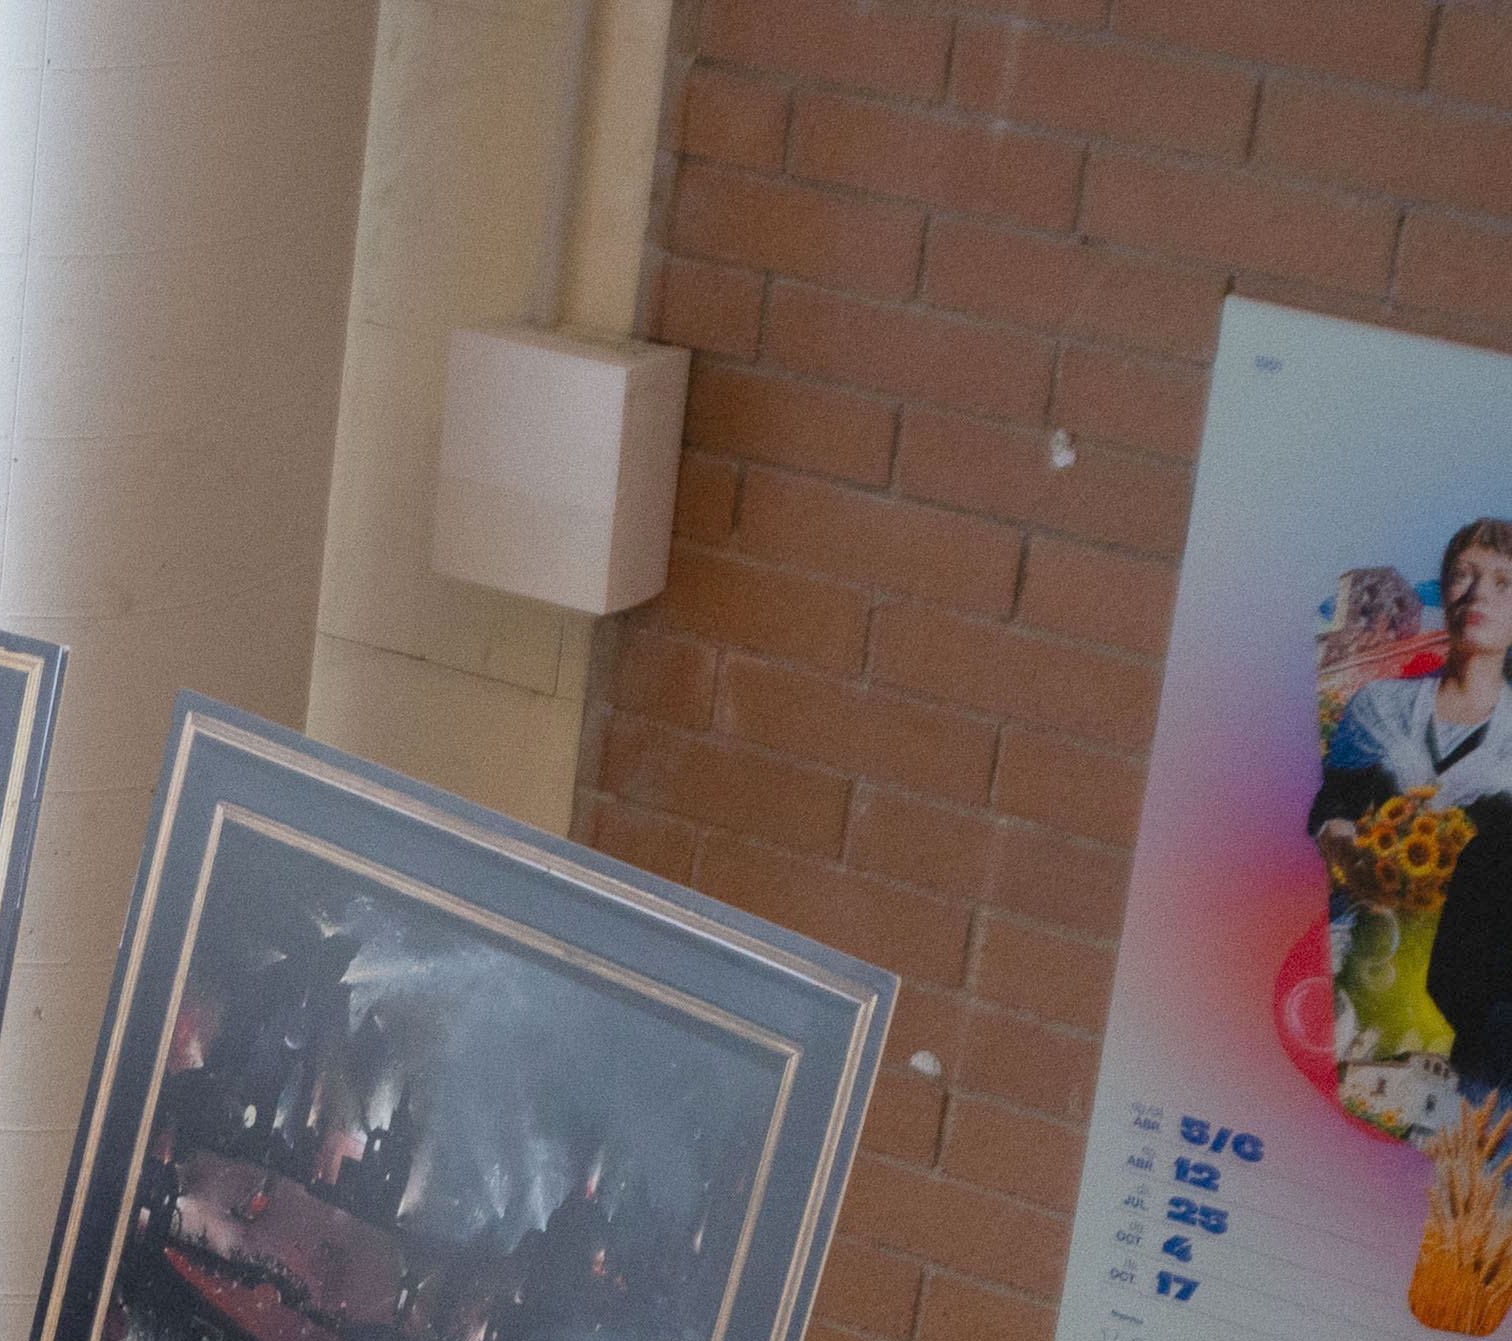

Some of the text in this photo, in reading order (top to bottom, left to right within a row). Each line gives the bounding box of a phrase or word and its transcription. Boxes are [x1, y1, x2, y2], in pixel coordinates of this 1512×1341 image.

[1180, 1115, 1264, 1163] 5/6
[1174, 1156, 1222, 1192] 12
[1167, 1196, 1229, 1235] 25
[1162, 1234, 1193, 1263] 4
[1156, 1270, 1201, 1302] 17
